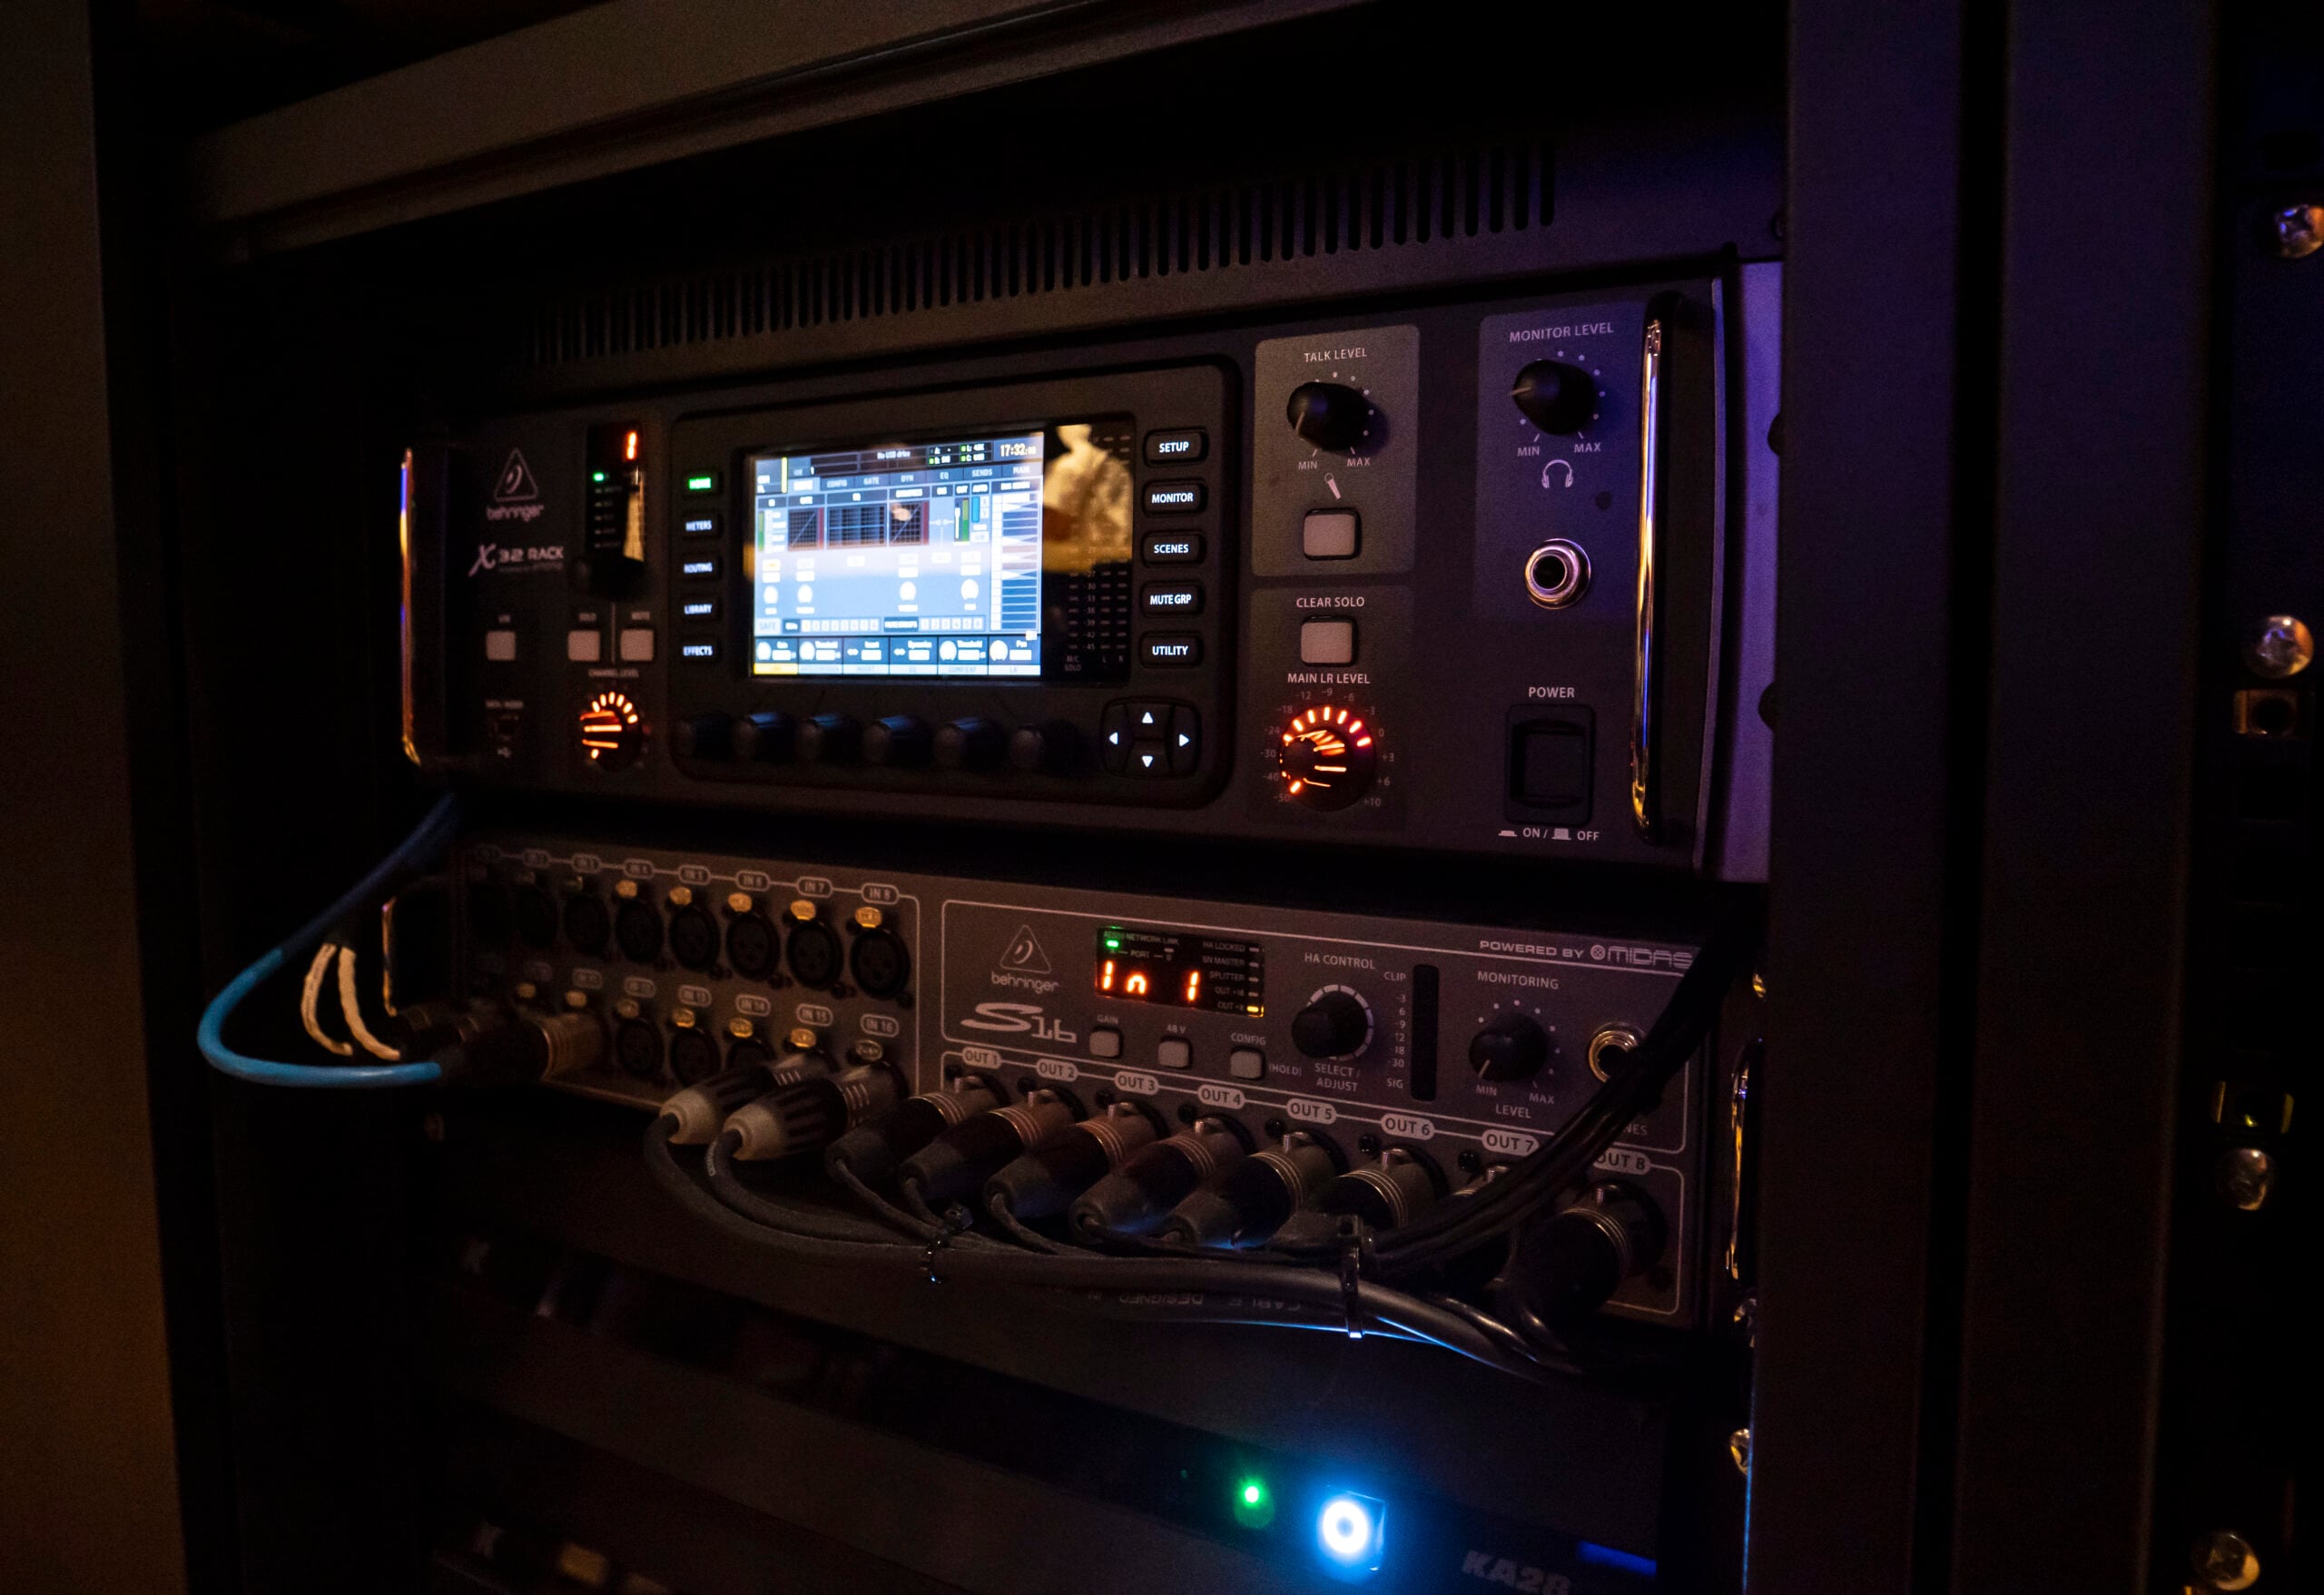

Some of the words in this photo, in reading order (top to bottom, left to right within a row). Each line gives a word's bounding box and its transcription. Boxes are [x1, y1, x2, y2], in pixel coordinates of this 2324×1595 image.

[1509, 327, 1571, 343] MONITOR
[1574, 322, 1614, 336] LEVEL
[1304, 349, 1331, 363] TALK
[1334, 347, 1367, 360] LEVEL
[1158, 441, 1189, 454] SETUP
[1517, 446, 1540, 457] MIN
[1573, 442, 1601, 453] MAX
[1297, 460, 1317, 470] MIN
[1346, 457, 1371, 467] MAX
[1151, 493, 1194, 504] MONITOR
[527, 546, 564, 560] RACK
[1153, 544, 1189, 554] SCENES
[1149, 595, 1174, 606] MUTE
[1174, 594, 1192, 606] GRP
[1296, 597, 1332, 608] CLEAR
[1334, 596, 1365, 607] SOLO
[1151, 645, 1189, 655] UTILITY
[1287, 673, 1317, 684] MAIN
[1320, 673, 1334, 684] LR
[1336, 674, 1370, 684] LEVEL
[1295, 691, 1312, 701] -12
[1528, 686, 1575, 698] POWER
[1522, 827, 1541, 838] ON
[1577, 831, 1600, 842] OFF
[804, 881, 816, 892] IN
[869, 889, 881, 900] IN
[1305, 953, 1320, 964] HA
[1323, 954, 1376, 970] CONTROL
[1480, 940, 1557, 957] POWERED
[1562, 948, 1584, 960] BY
[1607, 945, 1693, 969] MIDAS
[991, 970, 1059, 994] behringer
[1384, 971, 1406, 981] CLIP
[1477, 970, 1560, 989] MONITORING
[1097, 1014, 1119, 1025] GAIN
[1230, 1032, 1266, 1046] CONFIG
[965, 1051, 988, 1064] OUT
[1039, 1062, 1062, 1076] OUT
[1067, 1067, 1074, 1077] 2
[1315, 1063, 1354, 1077] SELECT
[1118, 1077, 1145, 1089] OUT
[1148, 1080, 1156, 1091] 3
[1316, 1078, 1358, 1092] ADJUST
[1386, 1078, 1403, 1088] SIG
[1201, 1089, 1229, 1103] OUT
[1233, 1093, 1241, 1105] 4
[1476, 1084, 1497, 1097] MIN
[1529, 1092, 1555, 1105] MAX
[1290, 1103, 1319, 1117] OUT
[1325, 1108, 1333, 1120] 5
[1495, 1104, 1532, 1119] LEVEL
[1385, 1117, 1416, 1134] OUT
[1422, 1124, 1430, 1136] 6
[1486, 1134, 1520, 1149] OUT
[1525, 1138, 1534, 1152] 7
[1636, 1157, 1646, 1170] 8
